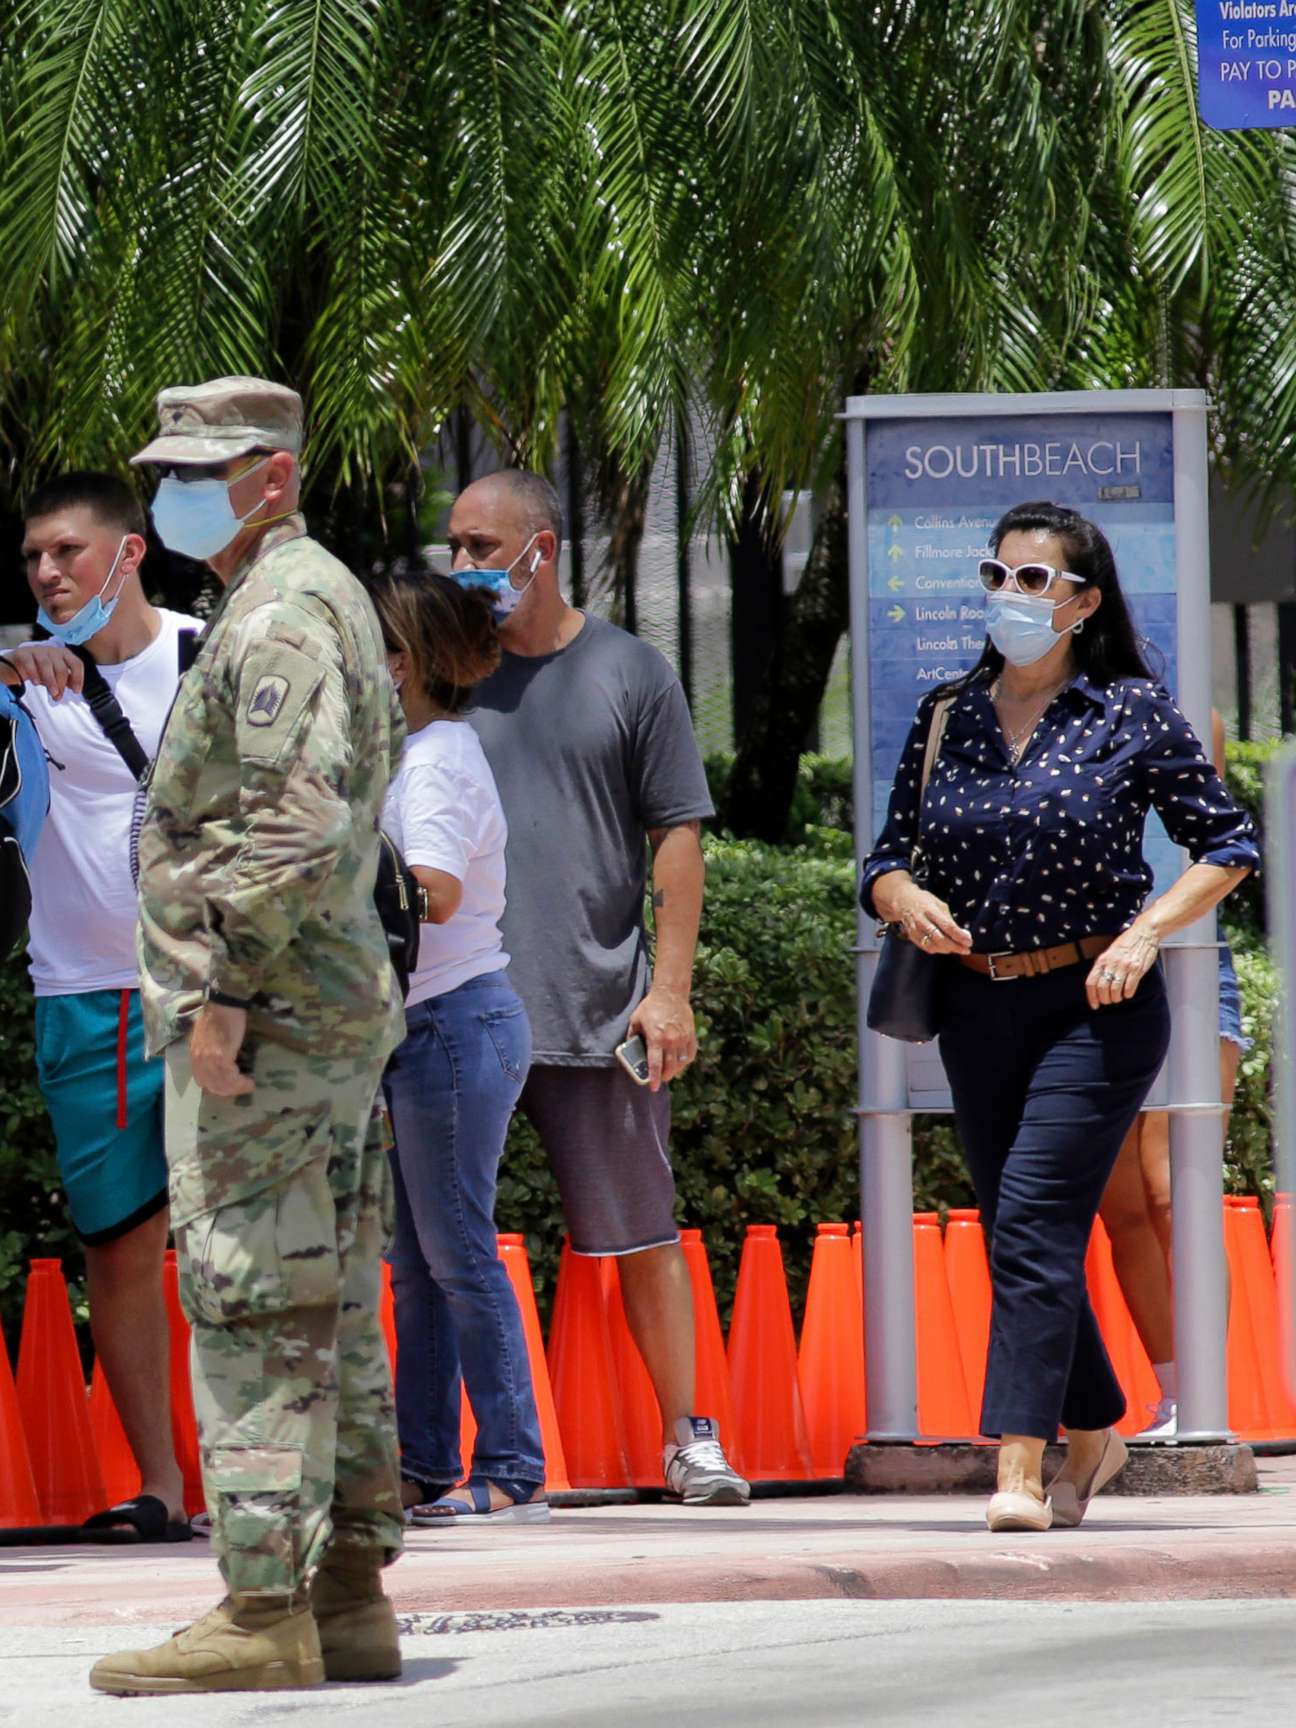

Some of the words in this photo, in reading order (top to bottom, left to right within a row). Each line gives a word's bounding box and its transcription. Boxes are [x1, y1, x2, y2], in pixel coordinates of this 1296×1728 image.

[1219, 0, 1276, 19] Violators
[1279, 0, 1296, 17] Ar
[1222, 30, 1243, 49] For
[1247, 26, 1296, 52] Parking
[1220, 61, 1251, 81] PAY
[1256, 60, 1282, 80] TO
[904, 440, 1141, 480] SOUTHBEACH
[914, 514, 954, 529] Collins
[959, 515, 997, 529] Avenu
[914, 544, 963, 559] Fillmore
[916, 605, 957, 621] Lincoln
[916, 635, 958, 651] Lincoln
